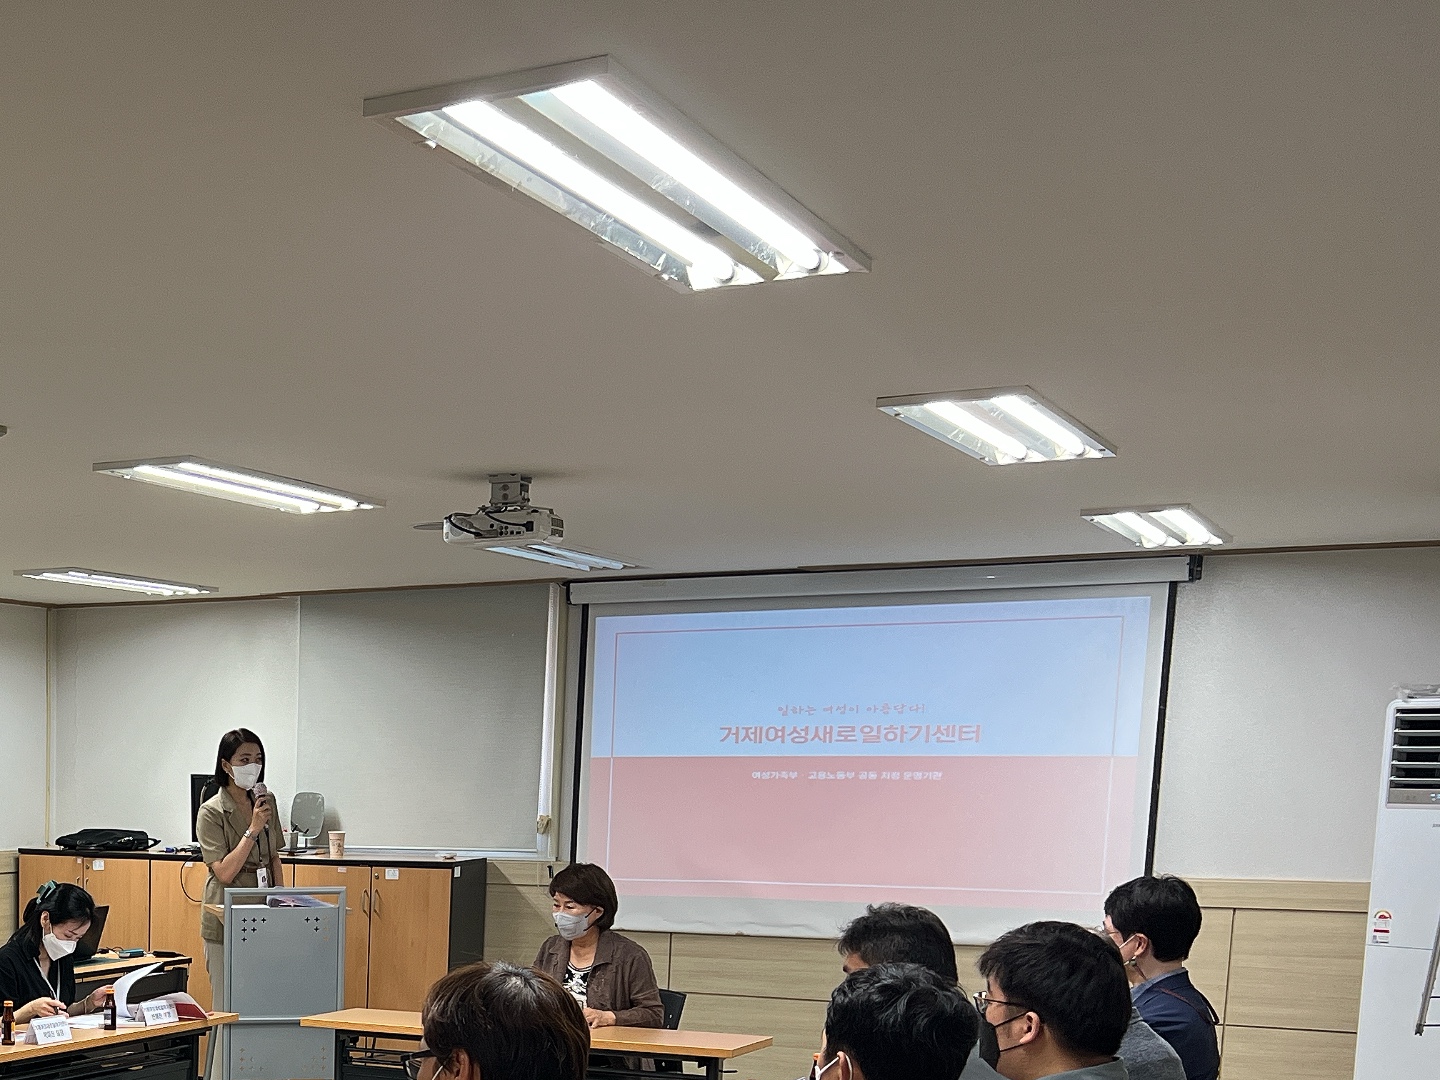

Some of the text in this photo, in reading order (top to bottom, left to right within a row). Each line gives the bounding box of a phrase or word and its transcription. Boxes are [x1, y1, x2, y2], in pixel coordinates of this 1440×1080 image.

[777, 704, 817, 717] 일하는
[822, 703, 860, 715] 여성이
[719, 724, 982, 744] 거제여성새로일하기센터
